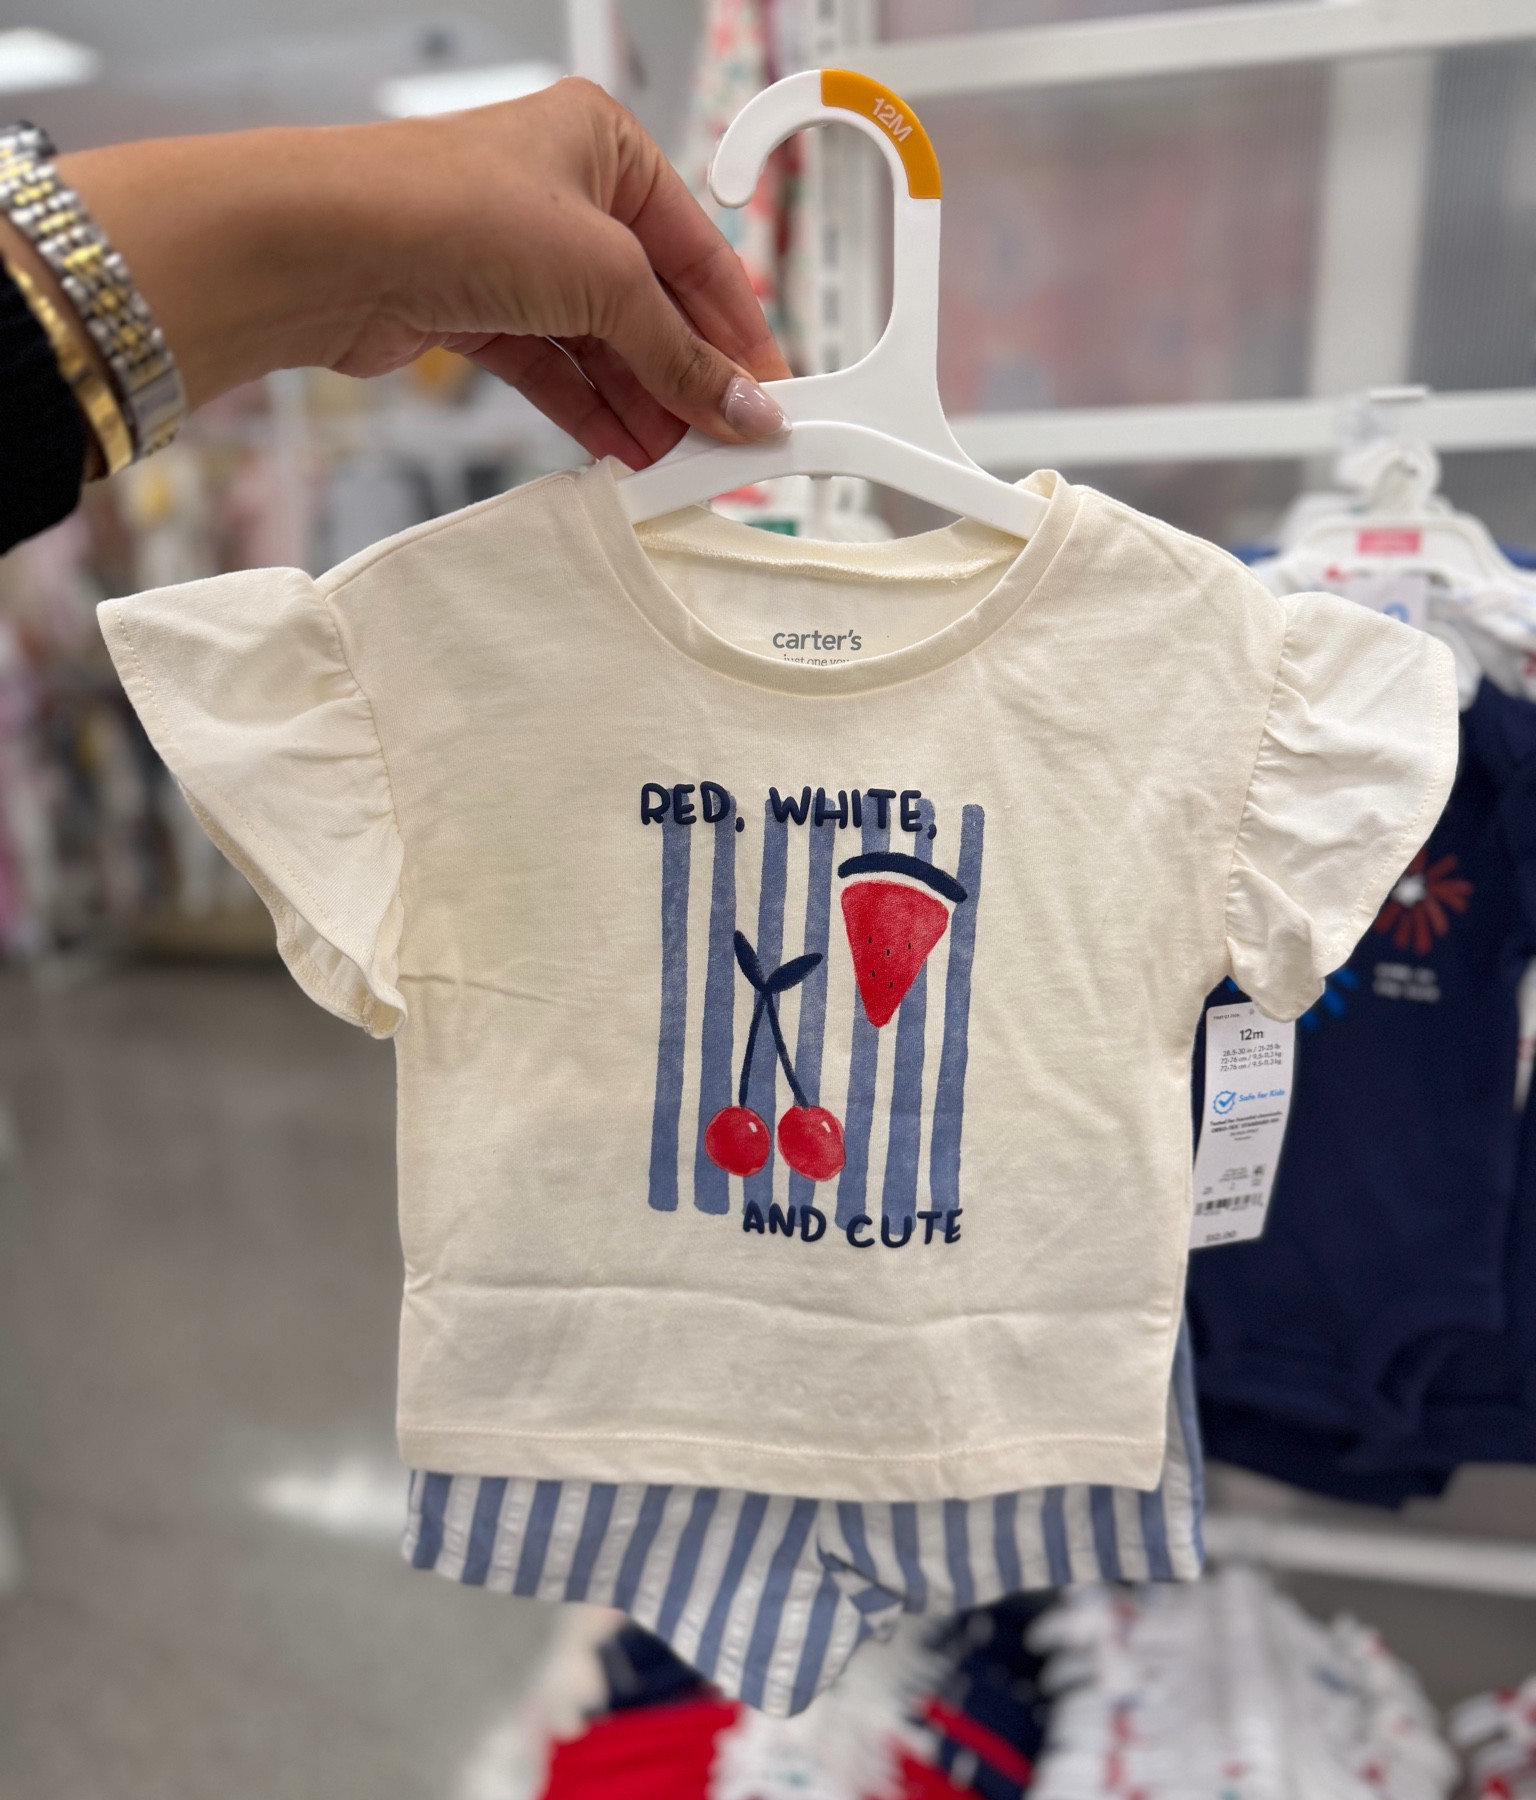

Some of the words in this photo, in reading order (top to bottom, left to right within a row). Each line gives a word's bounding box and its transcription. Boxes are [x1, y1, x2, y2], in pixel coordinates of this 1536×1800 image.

[873, 98, 913, 142] 12M
[772, 629, 862, 651] carter's
[807, 658, 828, 667] one
[641, 781, 745, 832] RED,
[769, 786, 937, 840] WHITE,
[1240, 1028, 1264, 1041] 12m
[1239, 1093, 1256, 1102] Safe
[1257, 1091, 1268, 1099] for
[1269, 1088, 1285, 1097] Kids
[742, 1200, 827, 1243] AND
[846, 1208, 963, 1248] CUTE
